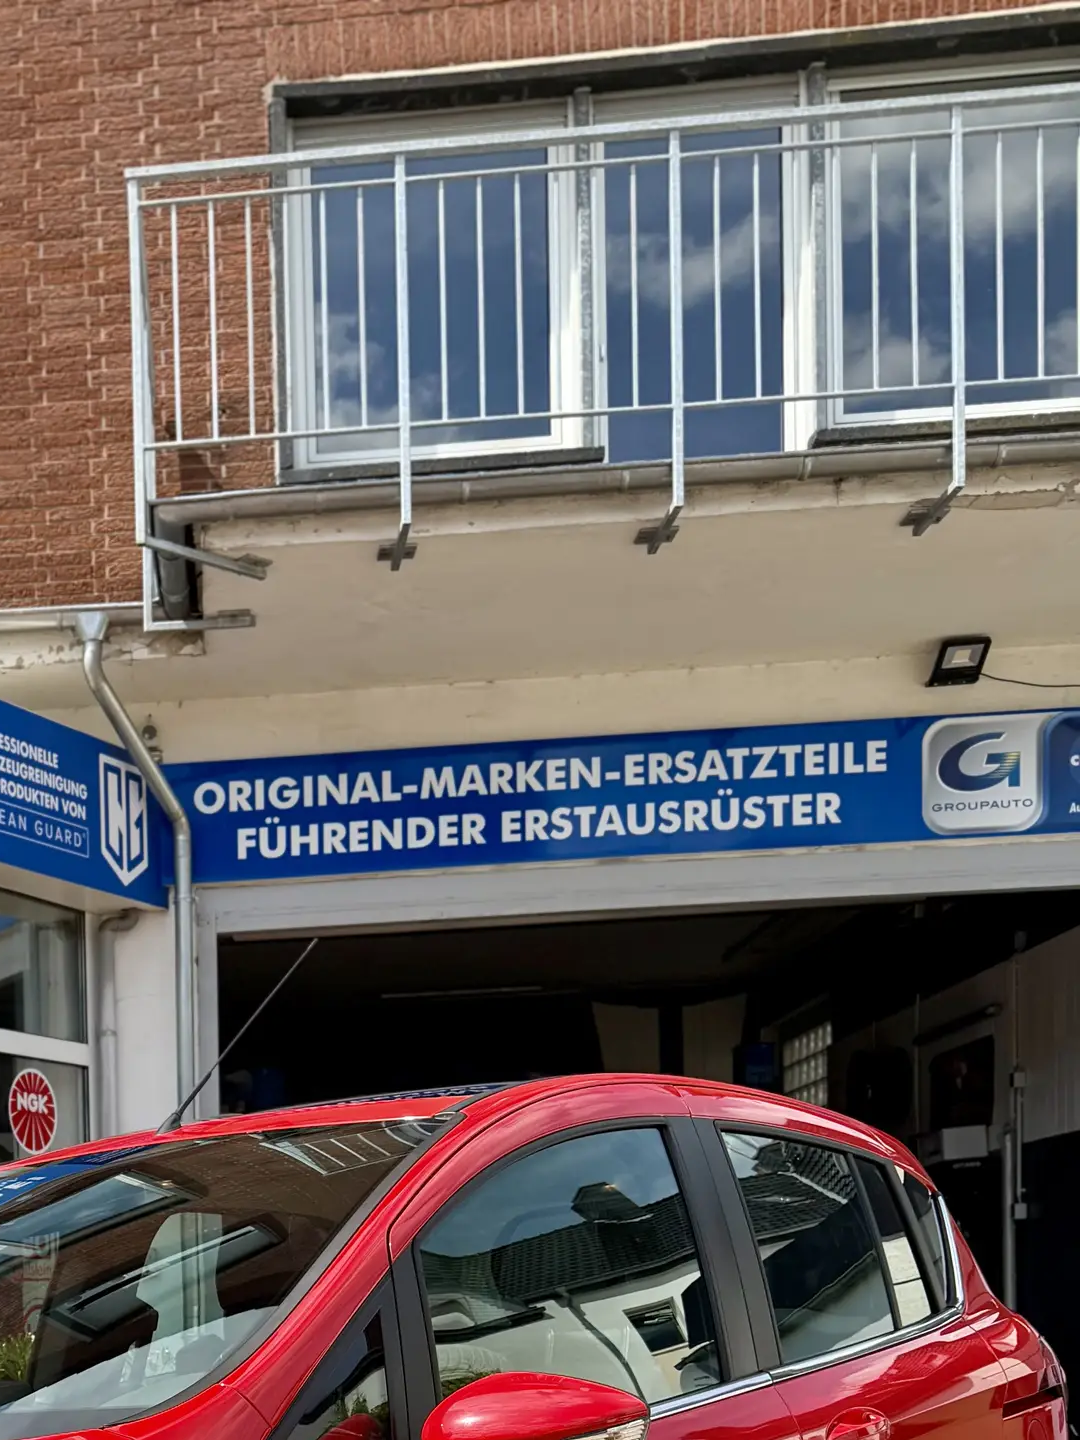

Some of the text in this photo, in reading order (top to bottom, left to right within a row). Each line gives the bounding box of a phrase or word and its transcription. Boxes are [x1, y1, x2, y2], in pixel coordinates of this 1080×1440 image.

[194, 741, 887, 813] ORIGINAL-MARKEN-ERSATZTEILE
[61, 798, 86, 821] VON
[931, 798, 1034, 813] GROUPAUTO
[238, 789, 840, 859] FÜHRENDER ERSTAUSRÜSTER
[16, 1091, 49, 1115] NGK
